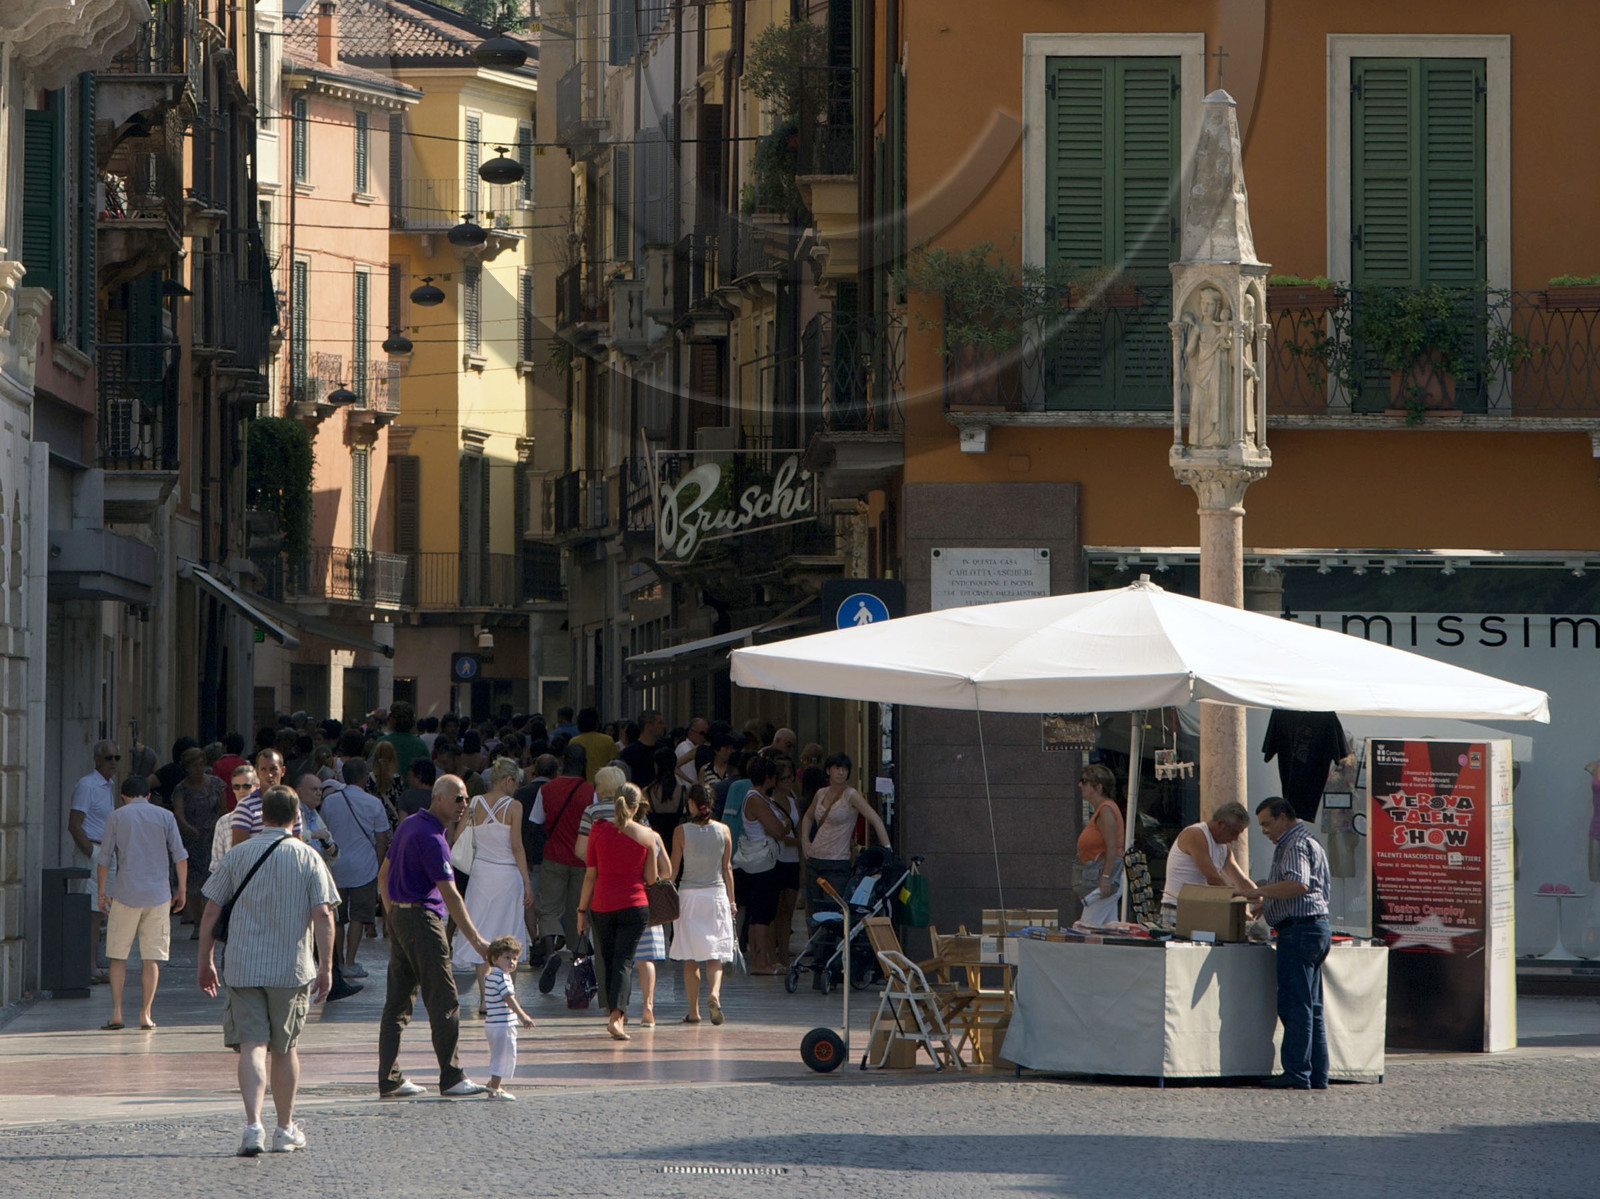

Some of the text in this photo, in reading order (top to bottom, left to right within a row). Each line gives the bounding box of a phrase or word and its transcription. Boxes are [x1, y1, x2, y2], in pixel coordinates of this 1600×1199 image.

[660, 454, 811, 558] Bruschi
[948, 568, 991, 576] CARLOTTA
[1389, 793, 1475, 811] VERONA
[1390, 808, 1472, 826] TALENT
[1393, 825, 1468, 847] SHOW
[1376, 851, 1402, 859] TALENTI
[1403, 852, 1434, 860] NASCOSTI
[1387, 902, 1465, 918] Teatro Camploy
